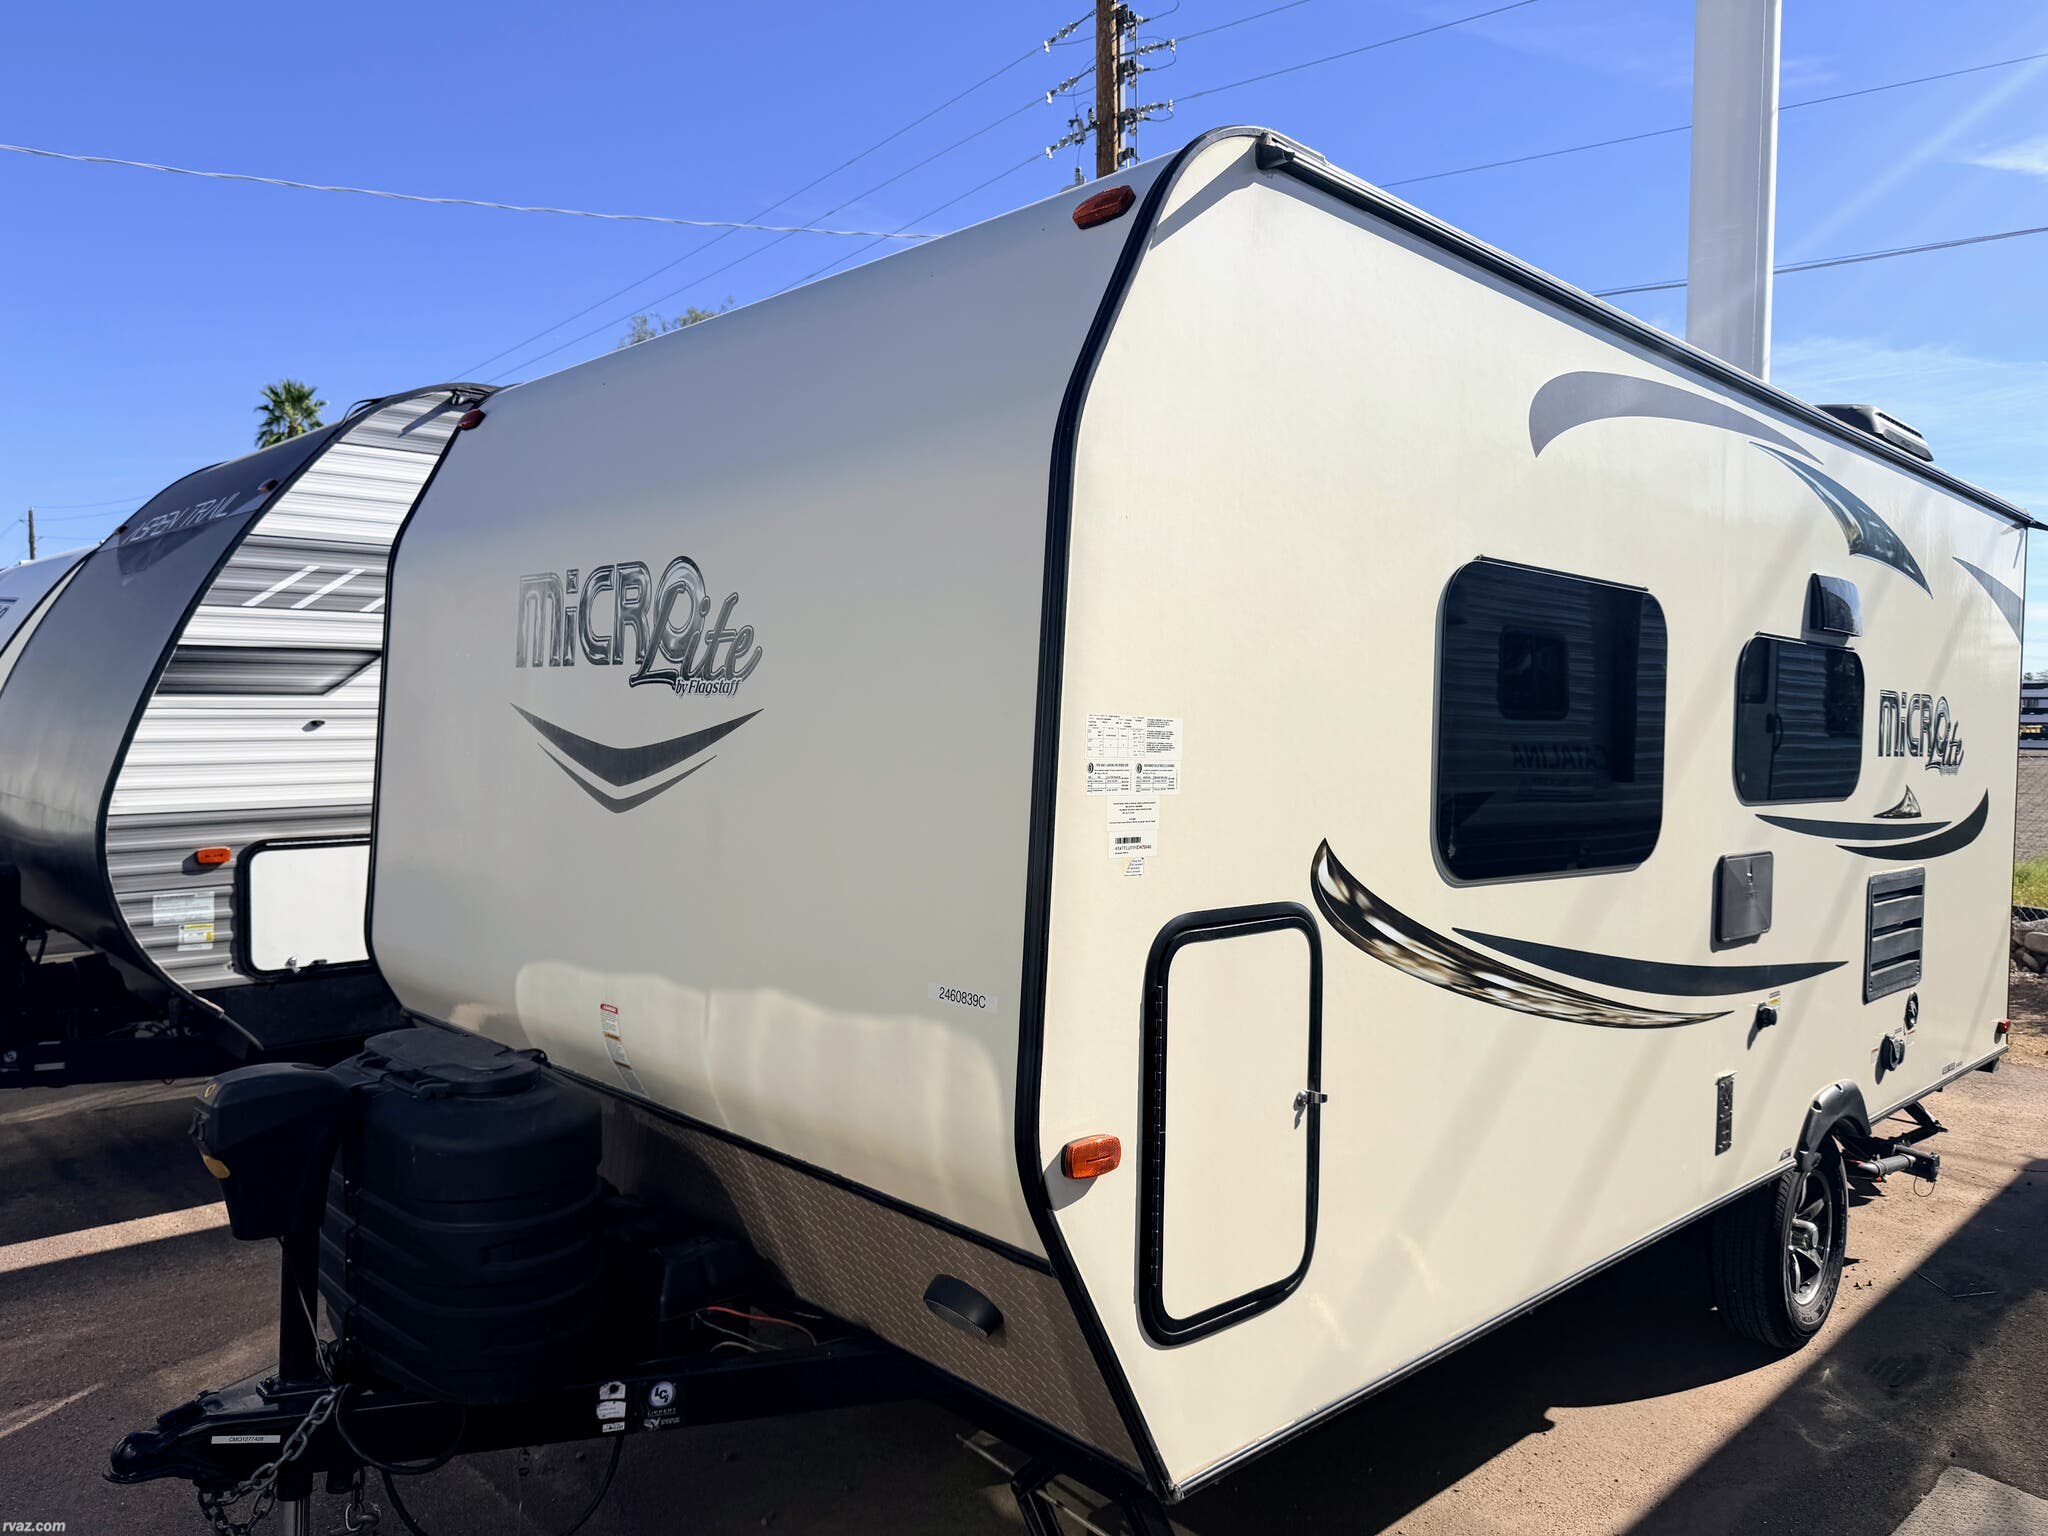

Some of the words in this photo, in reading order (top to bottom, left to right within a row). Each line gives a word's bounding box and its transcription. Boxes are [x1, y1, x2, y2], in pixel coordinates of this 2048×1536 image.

[179, 491, 240, 528] TRAIL
[629, 580, 763, 688] Lite
[675, 679, 688, 697] by
[688, 678, 741, 697] Flagstaff
[939, 986, 986, 1009] 2460839C
